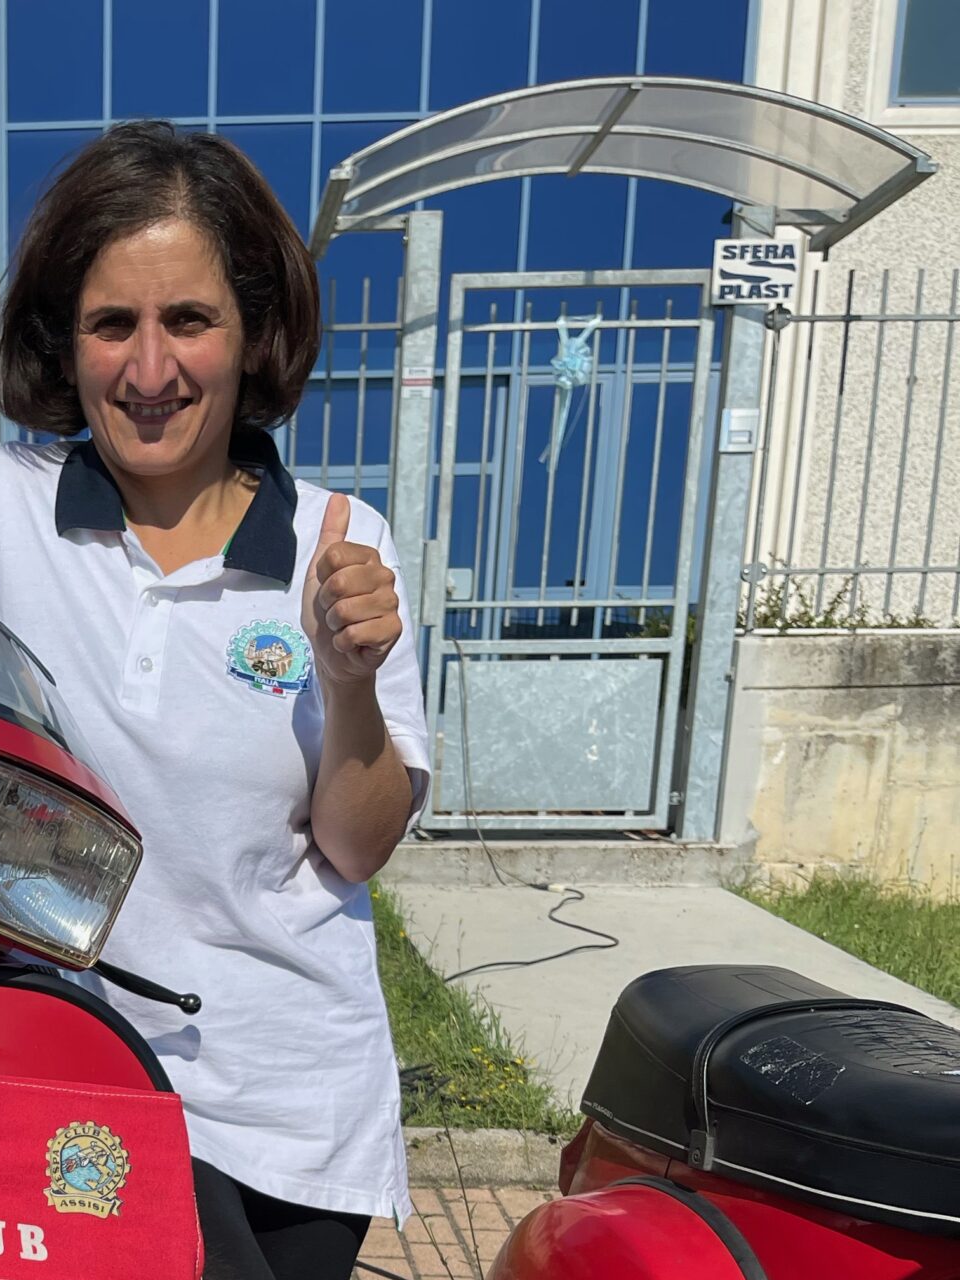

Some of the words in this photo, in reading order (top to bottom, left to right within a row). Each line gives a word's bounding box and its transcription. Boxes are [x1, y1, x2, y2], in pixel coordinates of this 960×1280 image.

[722, 244, 795, 260] SFERA
[719, 284, 793, 299] PLAST
[254, 676, 279, 688] ITALIA
[53, 1149, 66, 1190] VESPA
[64, 1127, 100, 1139] CLUB
[60, 1199, 105, 1213] ASSISI
